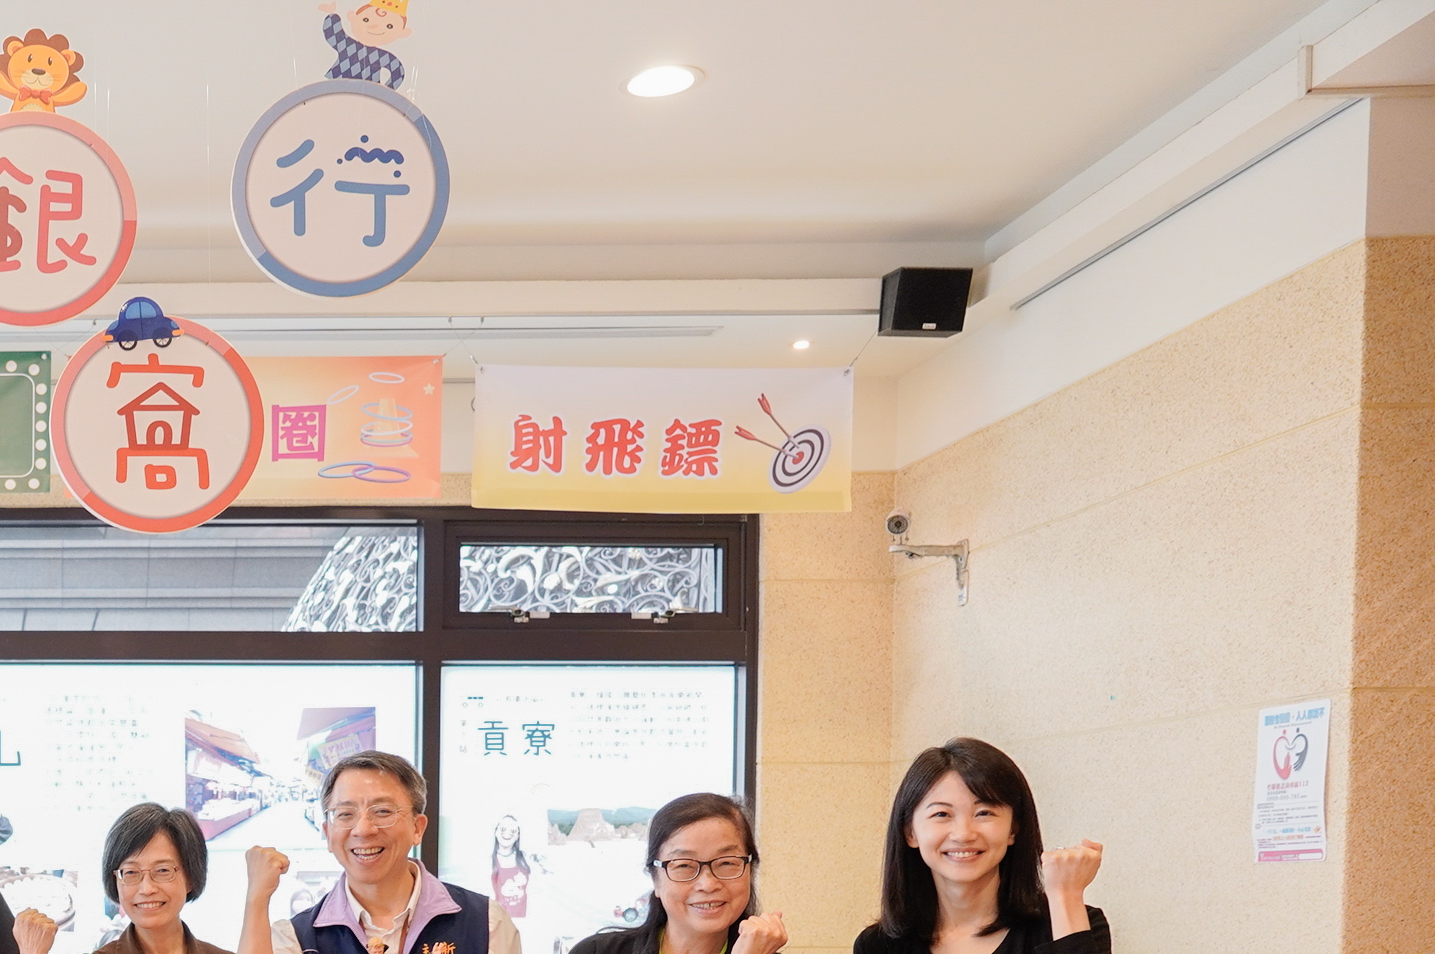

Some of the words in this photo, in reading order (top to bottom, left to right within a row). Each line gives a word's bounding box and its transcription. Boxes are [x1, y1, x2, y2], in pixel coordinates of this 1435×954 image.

[270, 134, 410, 248] 行
[271, 403, 327, 462] 圈
[509, 414, 723, 477] 射飛鏢
[477, 720, 556, 756] 貢寮
